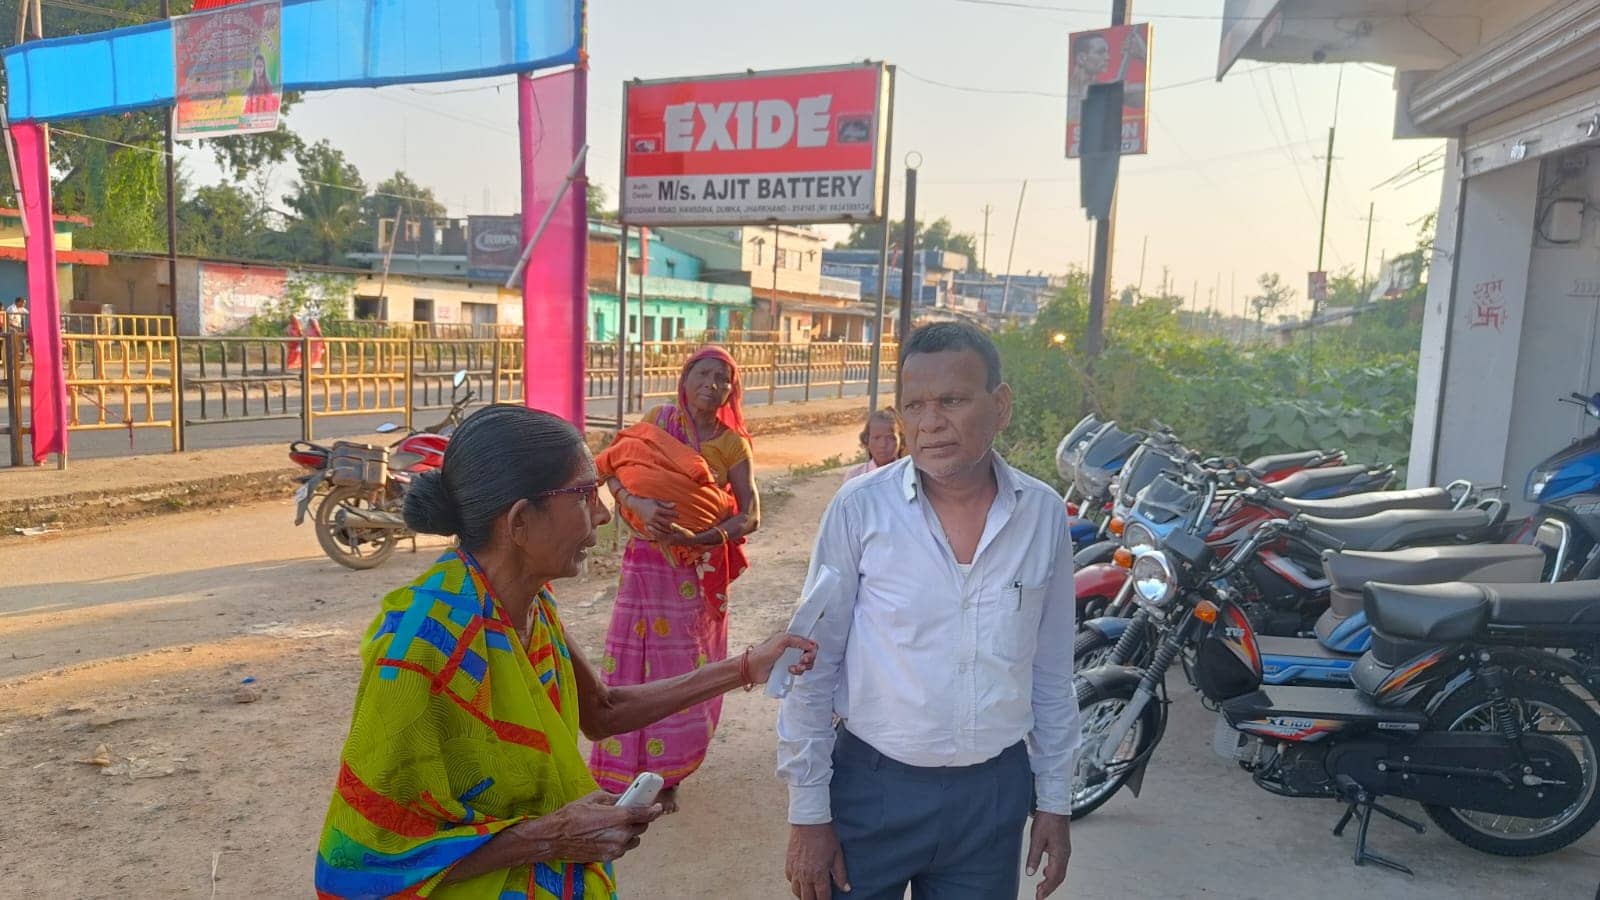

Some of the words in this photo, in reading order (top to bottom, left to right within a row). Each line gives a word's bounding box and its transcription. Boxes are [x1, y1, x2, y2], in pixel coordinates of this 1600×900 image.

[664, 94, 833, 152] EXIDE
[658, 179, 696, 201] M/s.
[703, 179, 750, 200] AJIT
[758, 176, 862, 199] BATTERY
